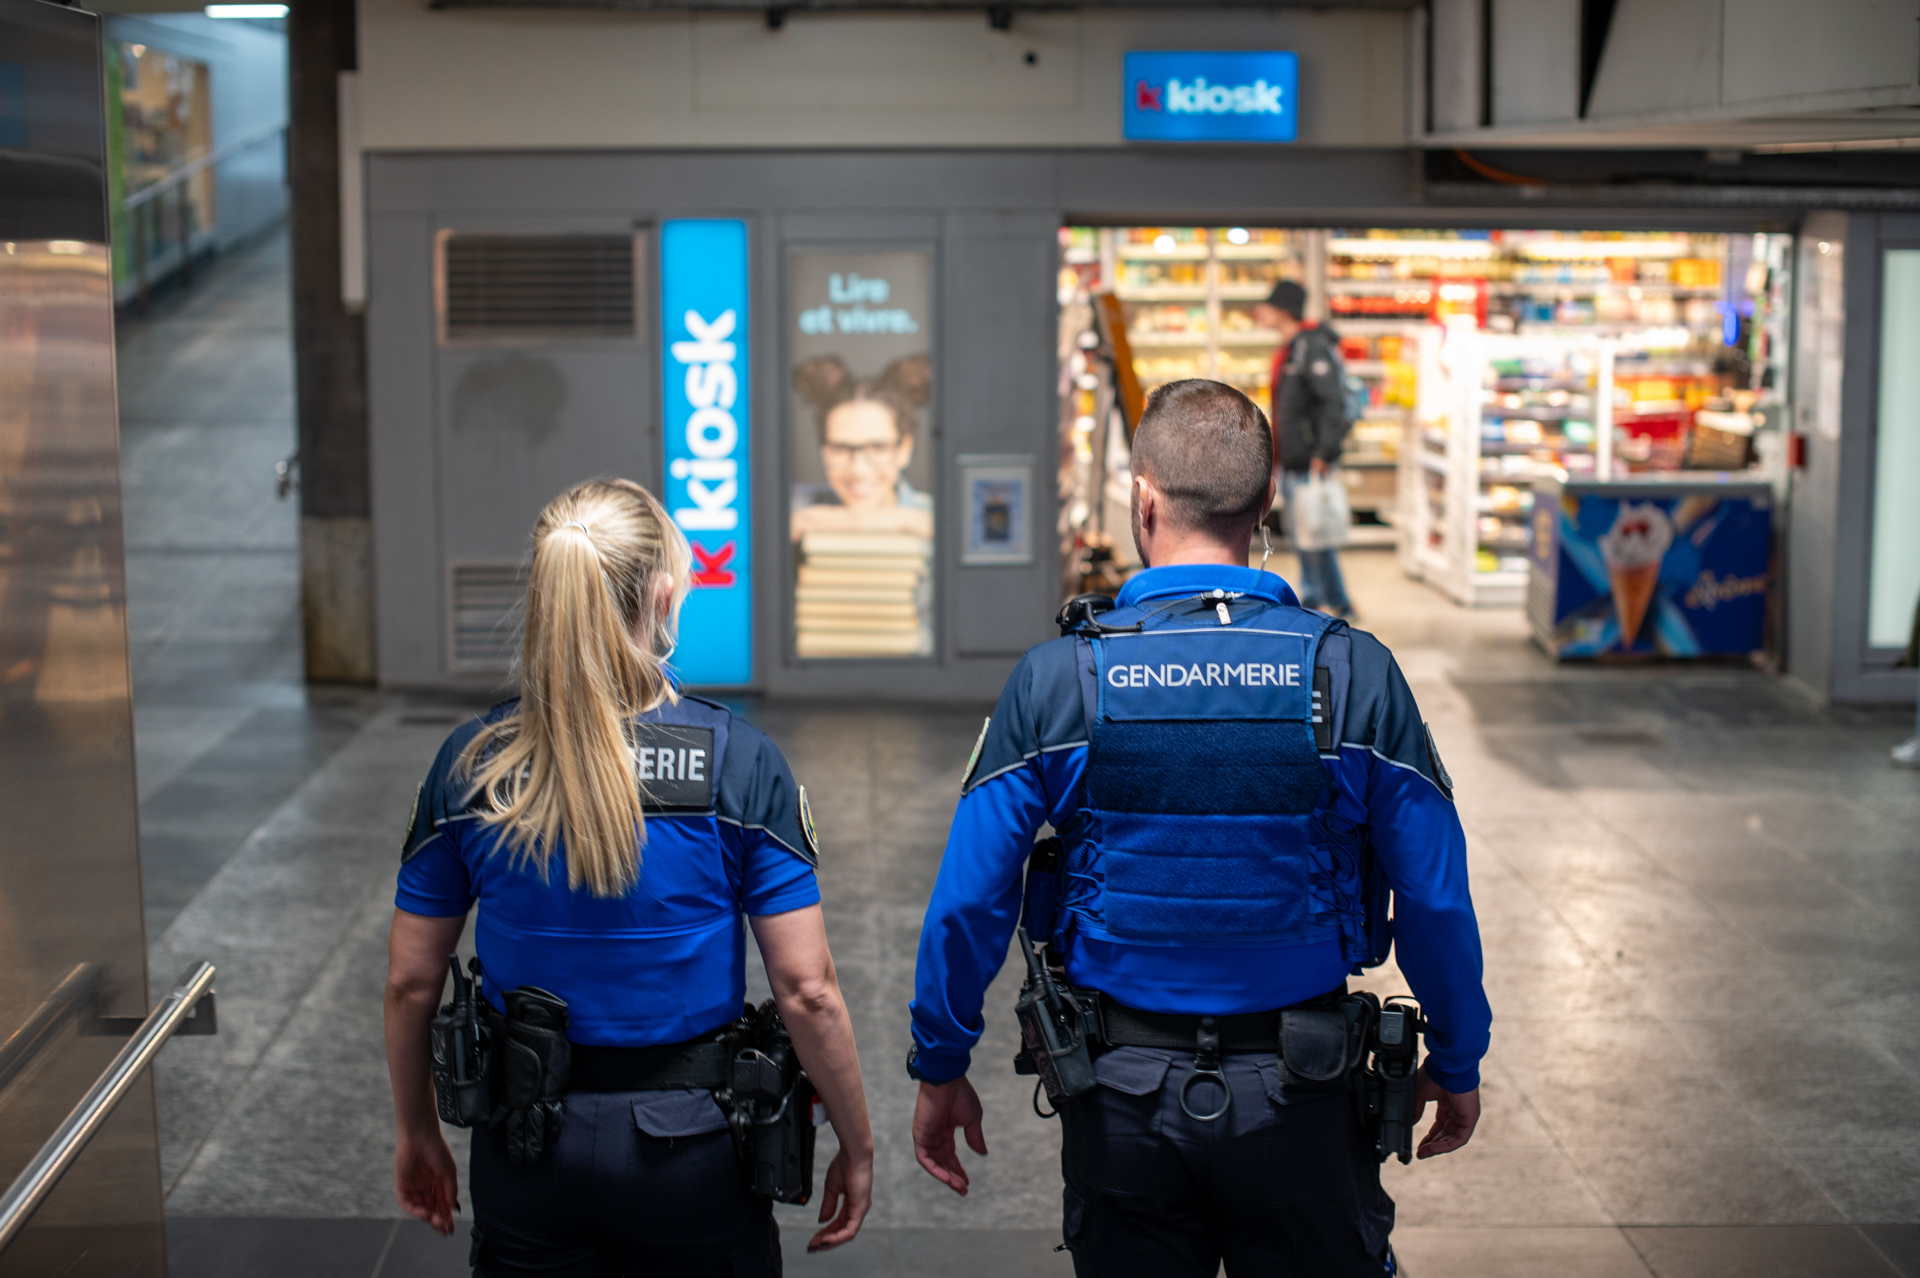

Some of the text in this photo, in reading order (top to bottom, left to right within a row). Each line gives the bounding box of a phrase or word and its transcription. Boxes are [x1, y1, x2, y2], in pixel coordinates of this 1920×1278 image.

[1136, 76, 1283, 114] k kiosk
[828, 271, 891, 304] Lire
[798, 304, 834, 335] et
[670, 308, 738, 530] kiosk
[1107, 663, 1300, 688] GENDARMERIE
[630, 746, 706, 781] ERIE
